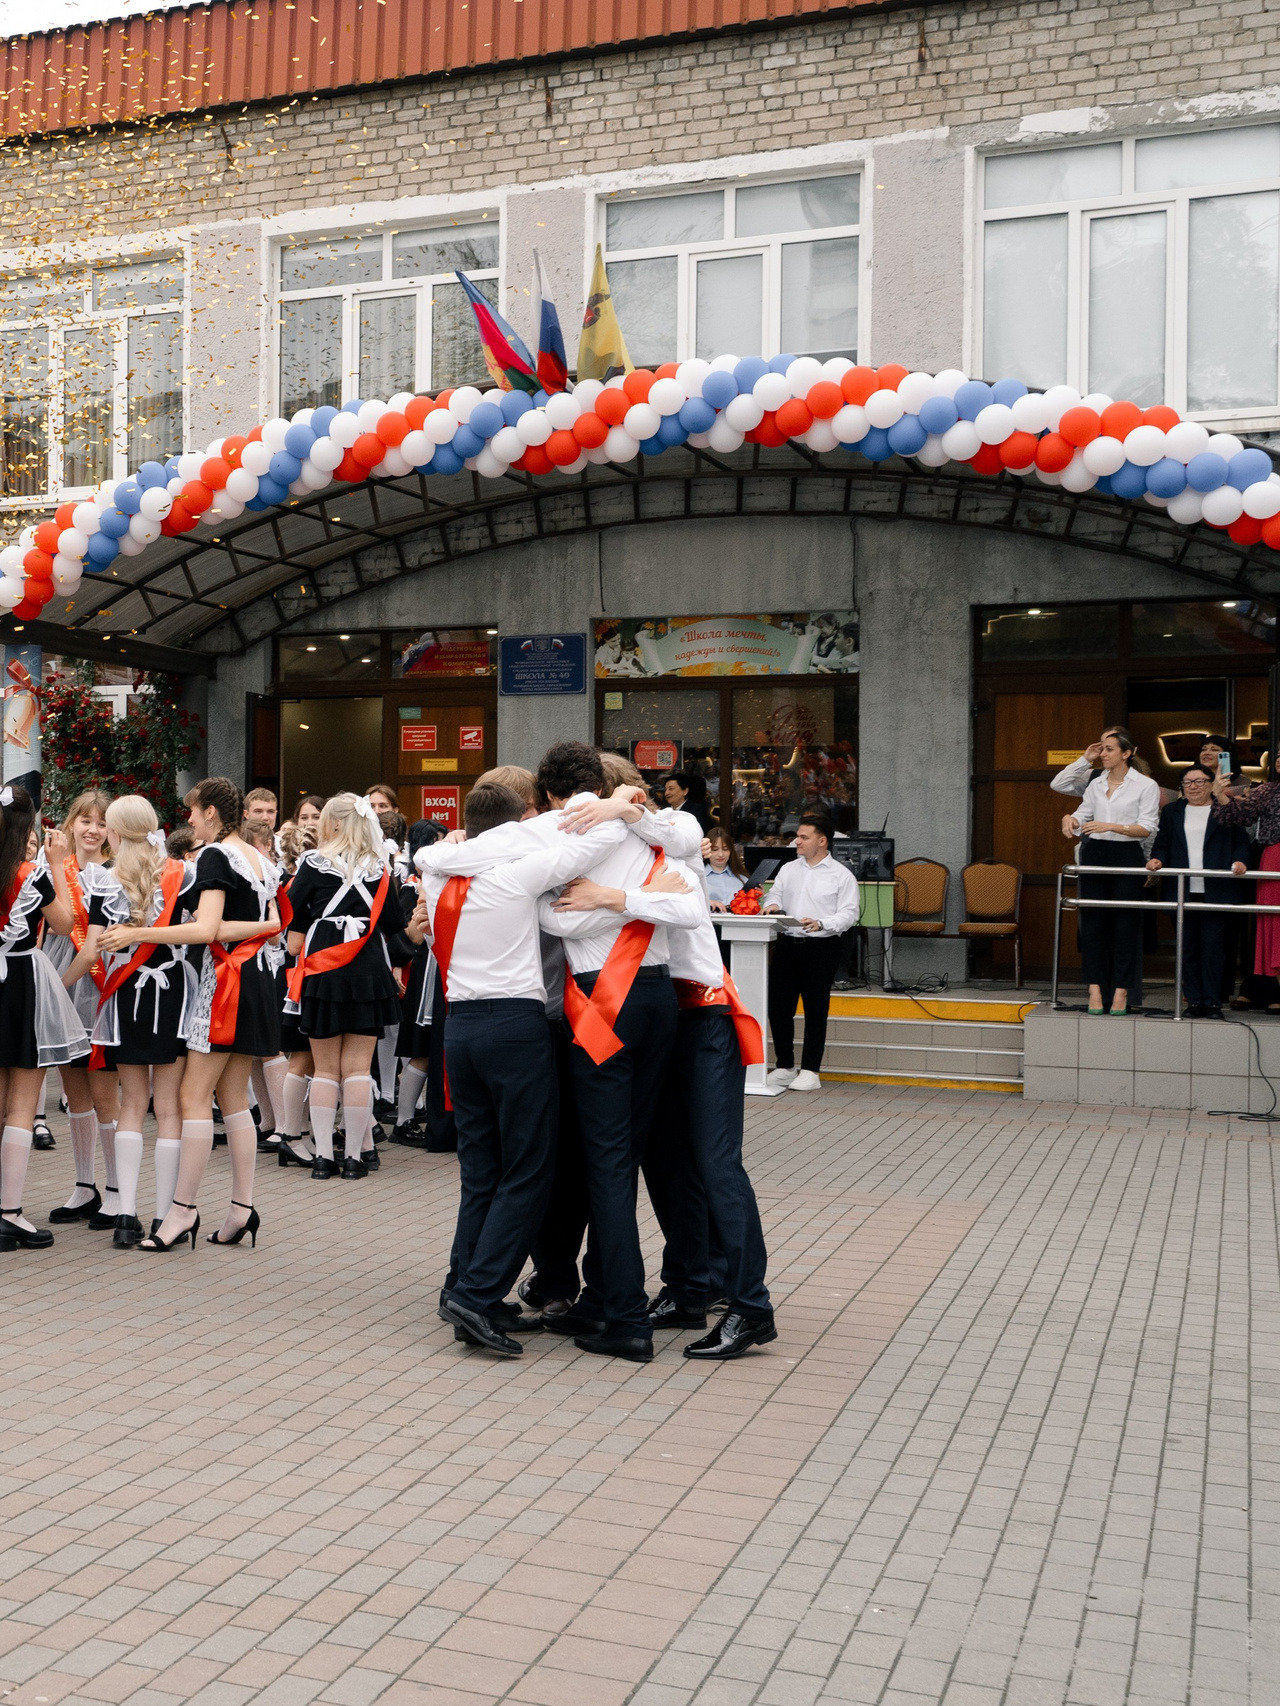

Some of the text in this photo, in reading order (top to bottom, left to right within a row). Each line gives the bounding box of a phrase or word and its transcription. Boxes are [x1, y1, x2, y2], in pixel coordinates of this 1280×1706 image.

[680, 630, 768, 643] «Школа мечты,
[675, 647, 716, 661] надежды
[726, 644, 781, 658] свершений!»
[515, 672, 546, 680] ШКОЛА
[425, 797, 456, 808] ВХОД
[431, 812, 449, 821] №1
